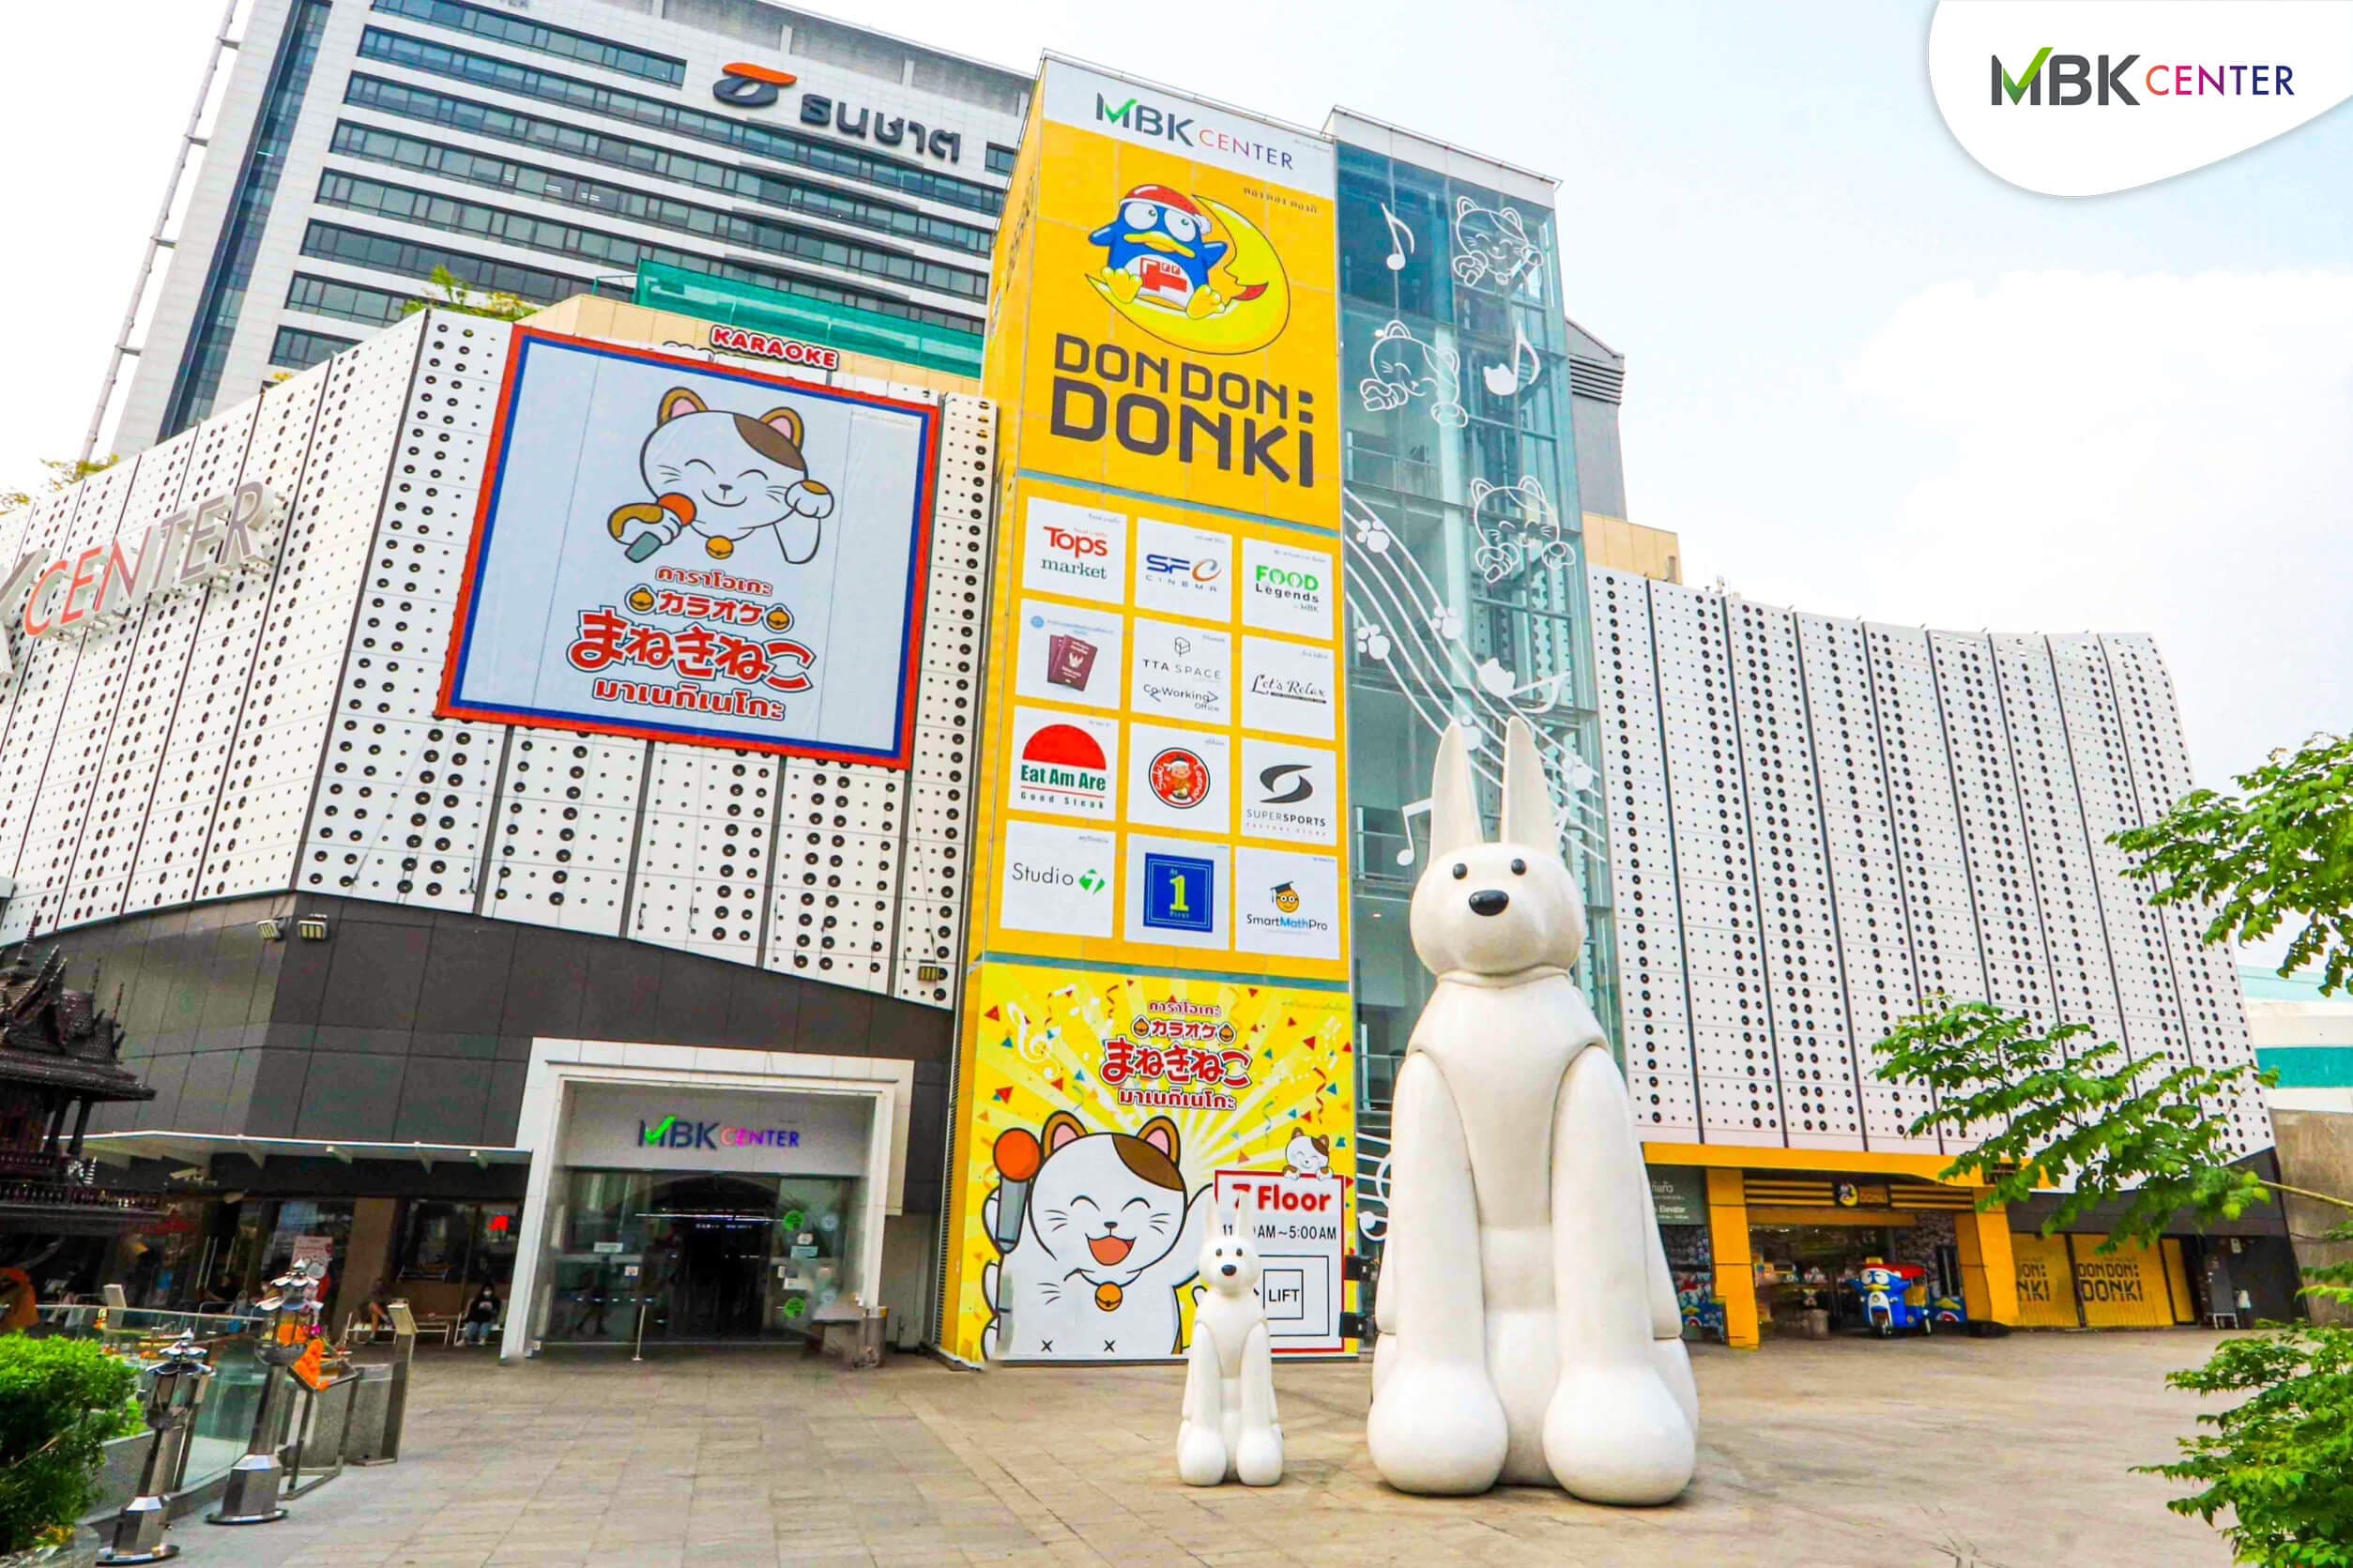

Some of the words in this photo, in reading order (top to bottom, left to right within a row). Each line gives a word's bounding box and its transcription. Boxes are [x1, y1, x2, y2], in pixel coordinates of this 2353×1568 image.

[801, 93, 961, 163] ธนชาต
[1095, 92, 1194, 147] MBK
[1199, 129, 1293, 170] CENTER
[712, 327, 837, 369] KARAOKE
[1043, 525, 1108, 559] Tops
[23, 481, 267, 637] CENTER
[1041, 557, 1108, 580] market
[1255, 564, 1319, 592] FOOD
[1255, 582, 1320, 603] Legends
[658, 591, 765, 625] カラオケ
[568, 607, 816, 692] まねきねこ
[1142, 659, 1169, 672] TTA
[1174, 663, 1222, 680] SPACE
[593, 677, 786, 721] มาเนกิเนโกะ
[1287, 679, 1324, 697] Relax
[1194, 701, 1220, 712] Office
[1020, 764, 1047, 784] Eat
[1049, 768, 1076, 788] Am
[1078, 771, 1107, 792] Are
[1020, 791, 1055, 804] Good
[1063, 796, 1105, 810] Steak
[1246, 809, 1327, 828] SUPERSPORTS
[1012, 861, 1075, 887] Studio
[1246, 913, 1328, 932] SmartMathPro
[1153, 1020, 1218, 1039] カラオケ
[1101, 1036, 1252, 1088] まねきねこ
[1119, 1088, 1236, 1110] มาเนกิเนโกะ
[637, 1114, 720, 1151] MBK
[721, 1127, 800, 1148] CENTER
[1258, 1183, 1332, 1212] Floor
[1268, 1288, 1300, 1302] LIFT
[2017, 1279, 2051, 1302] NKI
